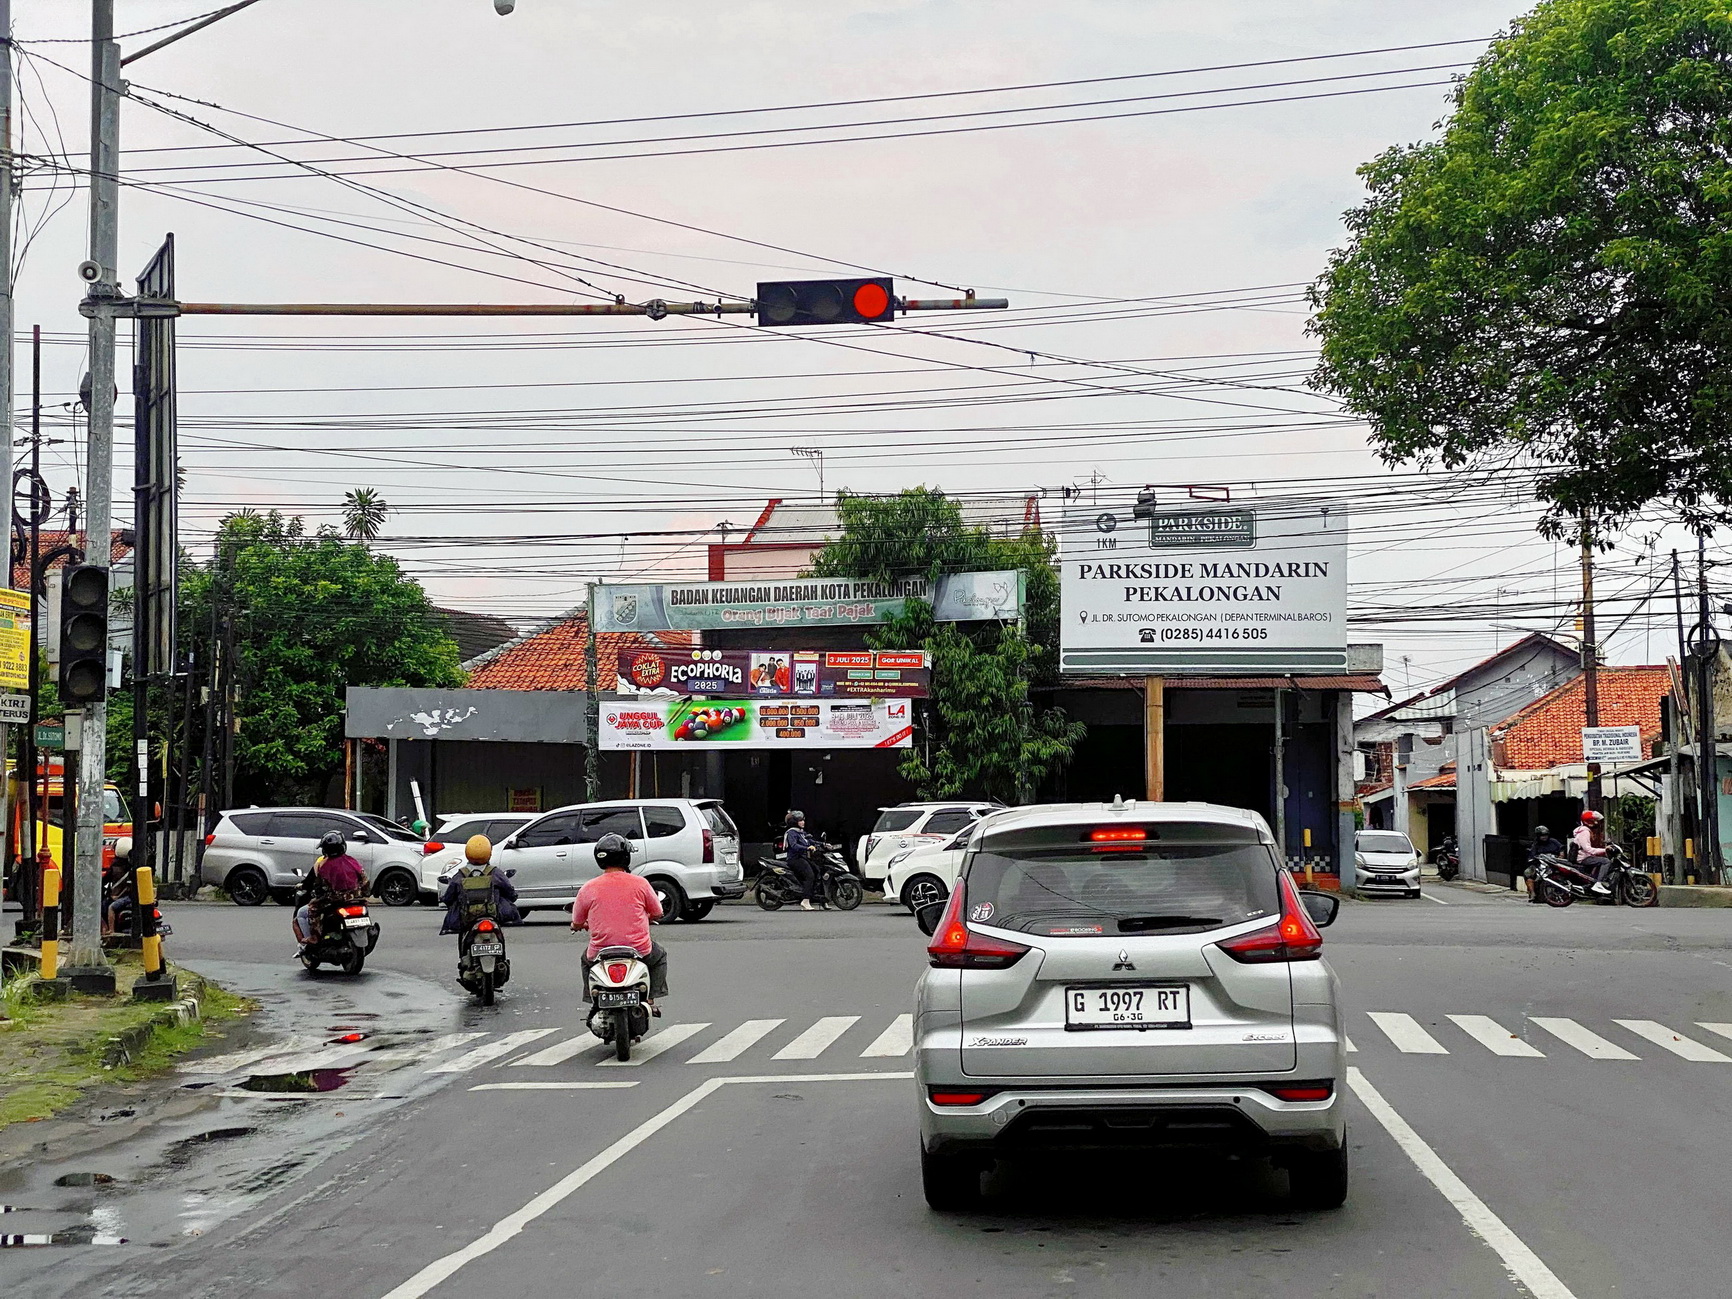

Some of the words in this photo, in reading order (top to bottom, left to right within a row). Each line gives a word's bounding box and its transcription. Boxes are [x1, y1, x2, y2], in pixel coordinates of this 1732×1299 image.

[1157, 515, 1243, 531] PARKSIDE
[1078, 563, 1194, 580] PARKSIDE
[1199, 561, 1330, 579] MANDARIN
[671, 588, 709, 606] BADAN
[711, 586, 772, 605] KEUANGAN
[773, 585, 818, 603] DAERAH
[820, 582, 851, 601] KOTA
[853, 579, 928, 599] PEKALONGAN
[1124, 585, 1282, 602] PEKALONGAN
[722, 608, 762, 625] Orang
[804, 605, 834, 619] Taat
[837, 603, 876, 622] Pajak
[1091, 613, 1101, 623] JL.
[1102, 613, 1116, 623] DR.
[1117, 613, 1156, 623] SUTOMO
[1157, 612, 1217, 622] PEKALONGAN
[1254, 612, 1297, 622] TERMINAL
[1160, 627, 1203, 642] (0285)
[851, 656, 870, 664] 2025
[632, 660, 660, 672] COKLAT
[641, 668, 660, 678] EXTRA
[694, 680, 718, 690] 2025
[0, 698, 27, 709] KIRI
[619, 711, 660, 722] UNGGUL
[615, 721, 642, 730] JAYA
[642, 720, 665, 731] CUP
[1608, 738, 1630, 747] ZUBAIR
[1073, 992, 1086, 1012] G
[1098, 990, 1145, 1012] 1997
[1157, 990, 1181, 1011] RT
